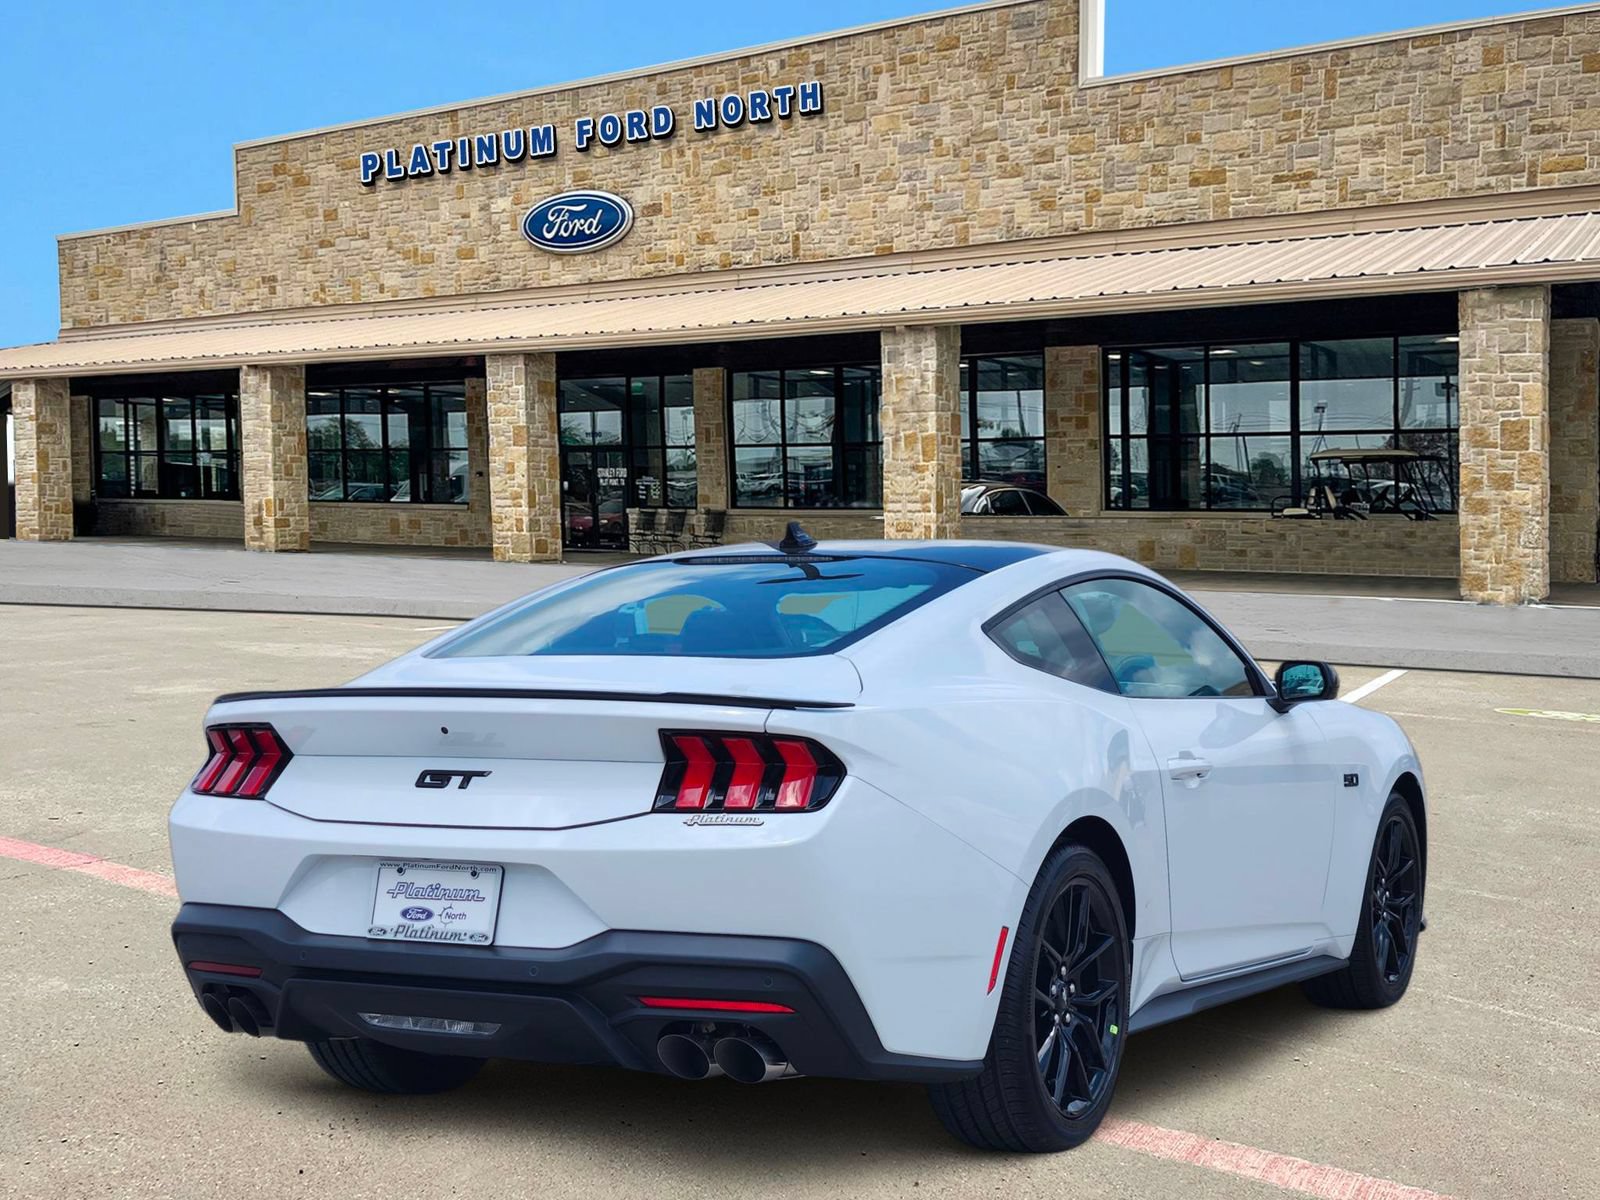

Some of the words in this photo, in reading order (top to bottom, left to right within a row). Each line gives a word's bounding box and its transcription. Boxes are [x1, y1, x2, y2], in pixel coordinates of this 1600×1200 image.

[360, 124, 557, 187] PLATINUM
[575, 105, 675, 153] FORD
[693, 81, 824, 132] NORTH
[541, 203, 603, 241] Ford
[415, 769, 493, 789] GT
[683, 812, 764, 827] Platinum
[380, 861, 497, 873] www.PlatinumFordNorth.com
[387, 881, 485, 902] Platinum
[405, 907, 429, 921] Ford
[445, 911, 467, 921] North
[393, 923, 465, 941] Platinum
